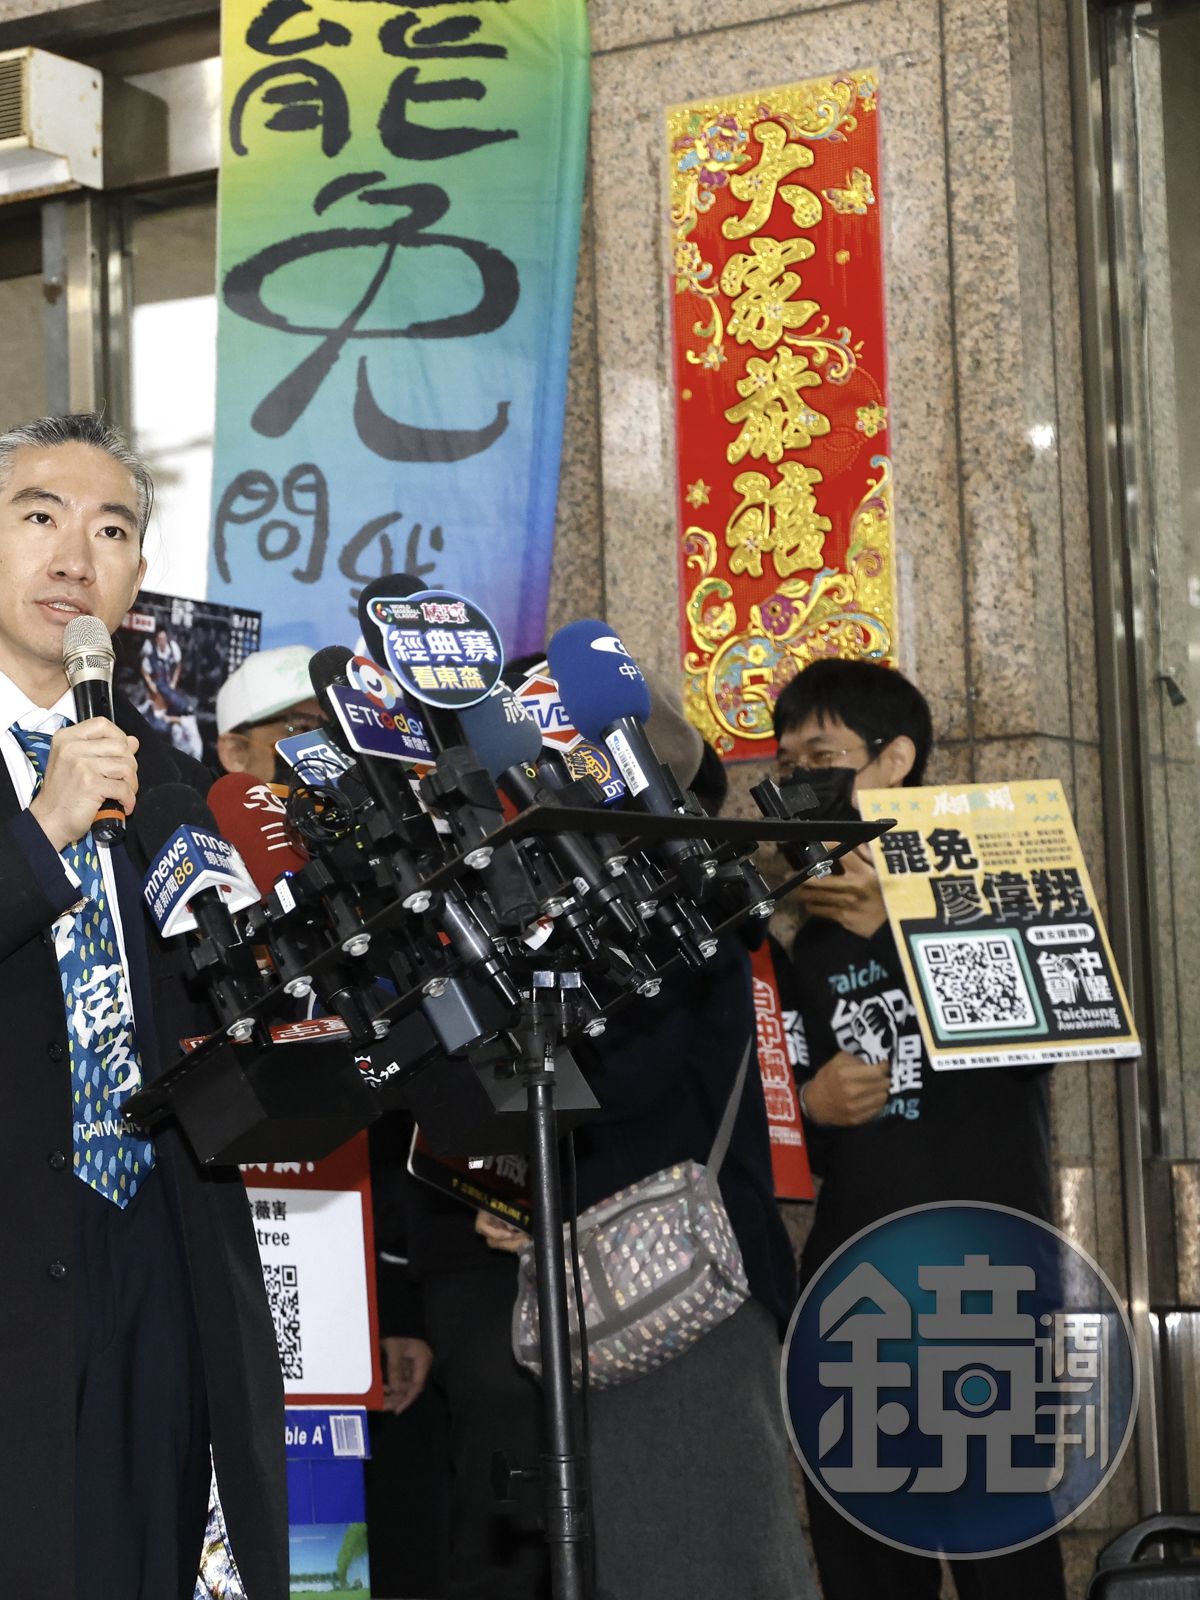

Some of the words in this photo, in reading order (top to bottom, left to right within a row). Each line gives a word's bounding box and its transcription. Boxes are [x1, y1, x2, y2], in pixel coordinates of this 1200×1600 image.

[388, 629, 498, 662] 經典賽
[410, 665, 487, 689] 看東森
[345, 703, 424, 736] ETtoda
[880, 828, 978, 874] 罷免
[143, 837, 188, 905] mnews
[930, 867, 1092, 925] 廖偉翔
[250, 1200, 287, 1221] 薇害
